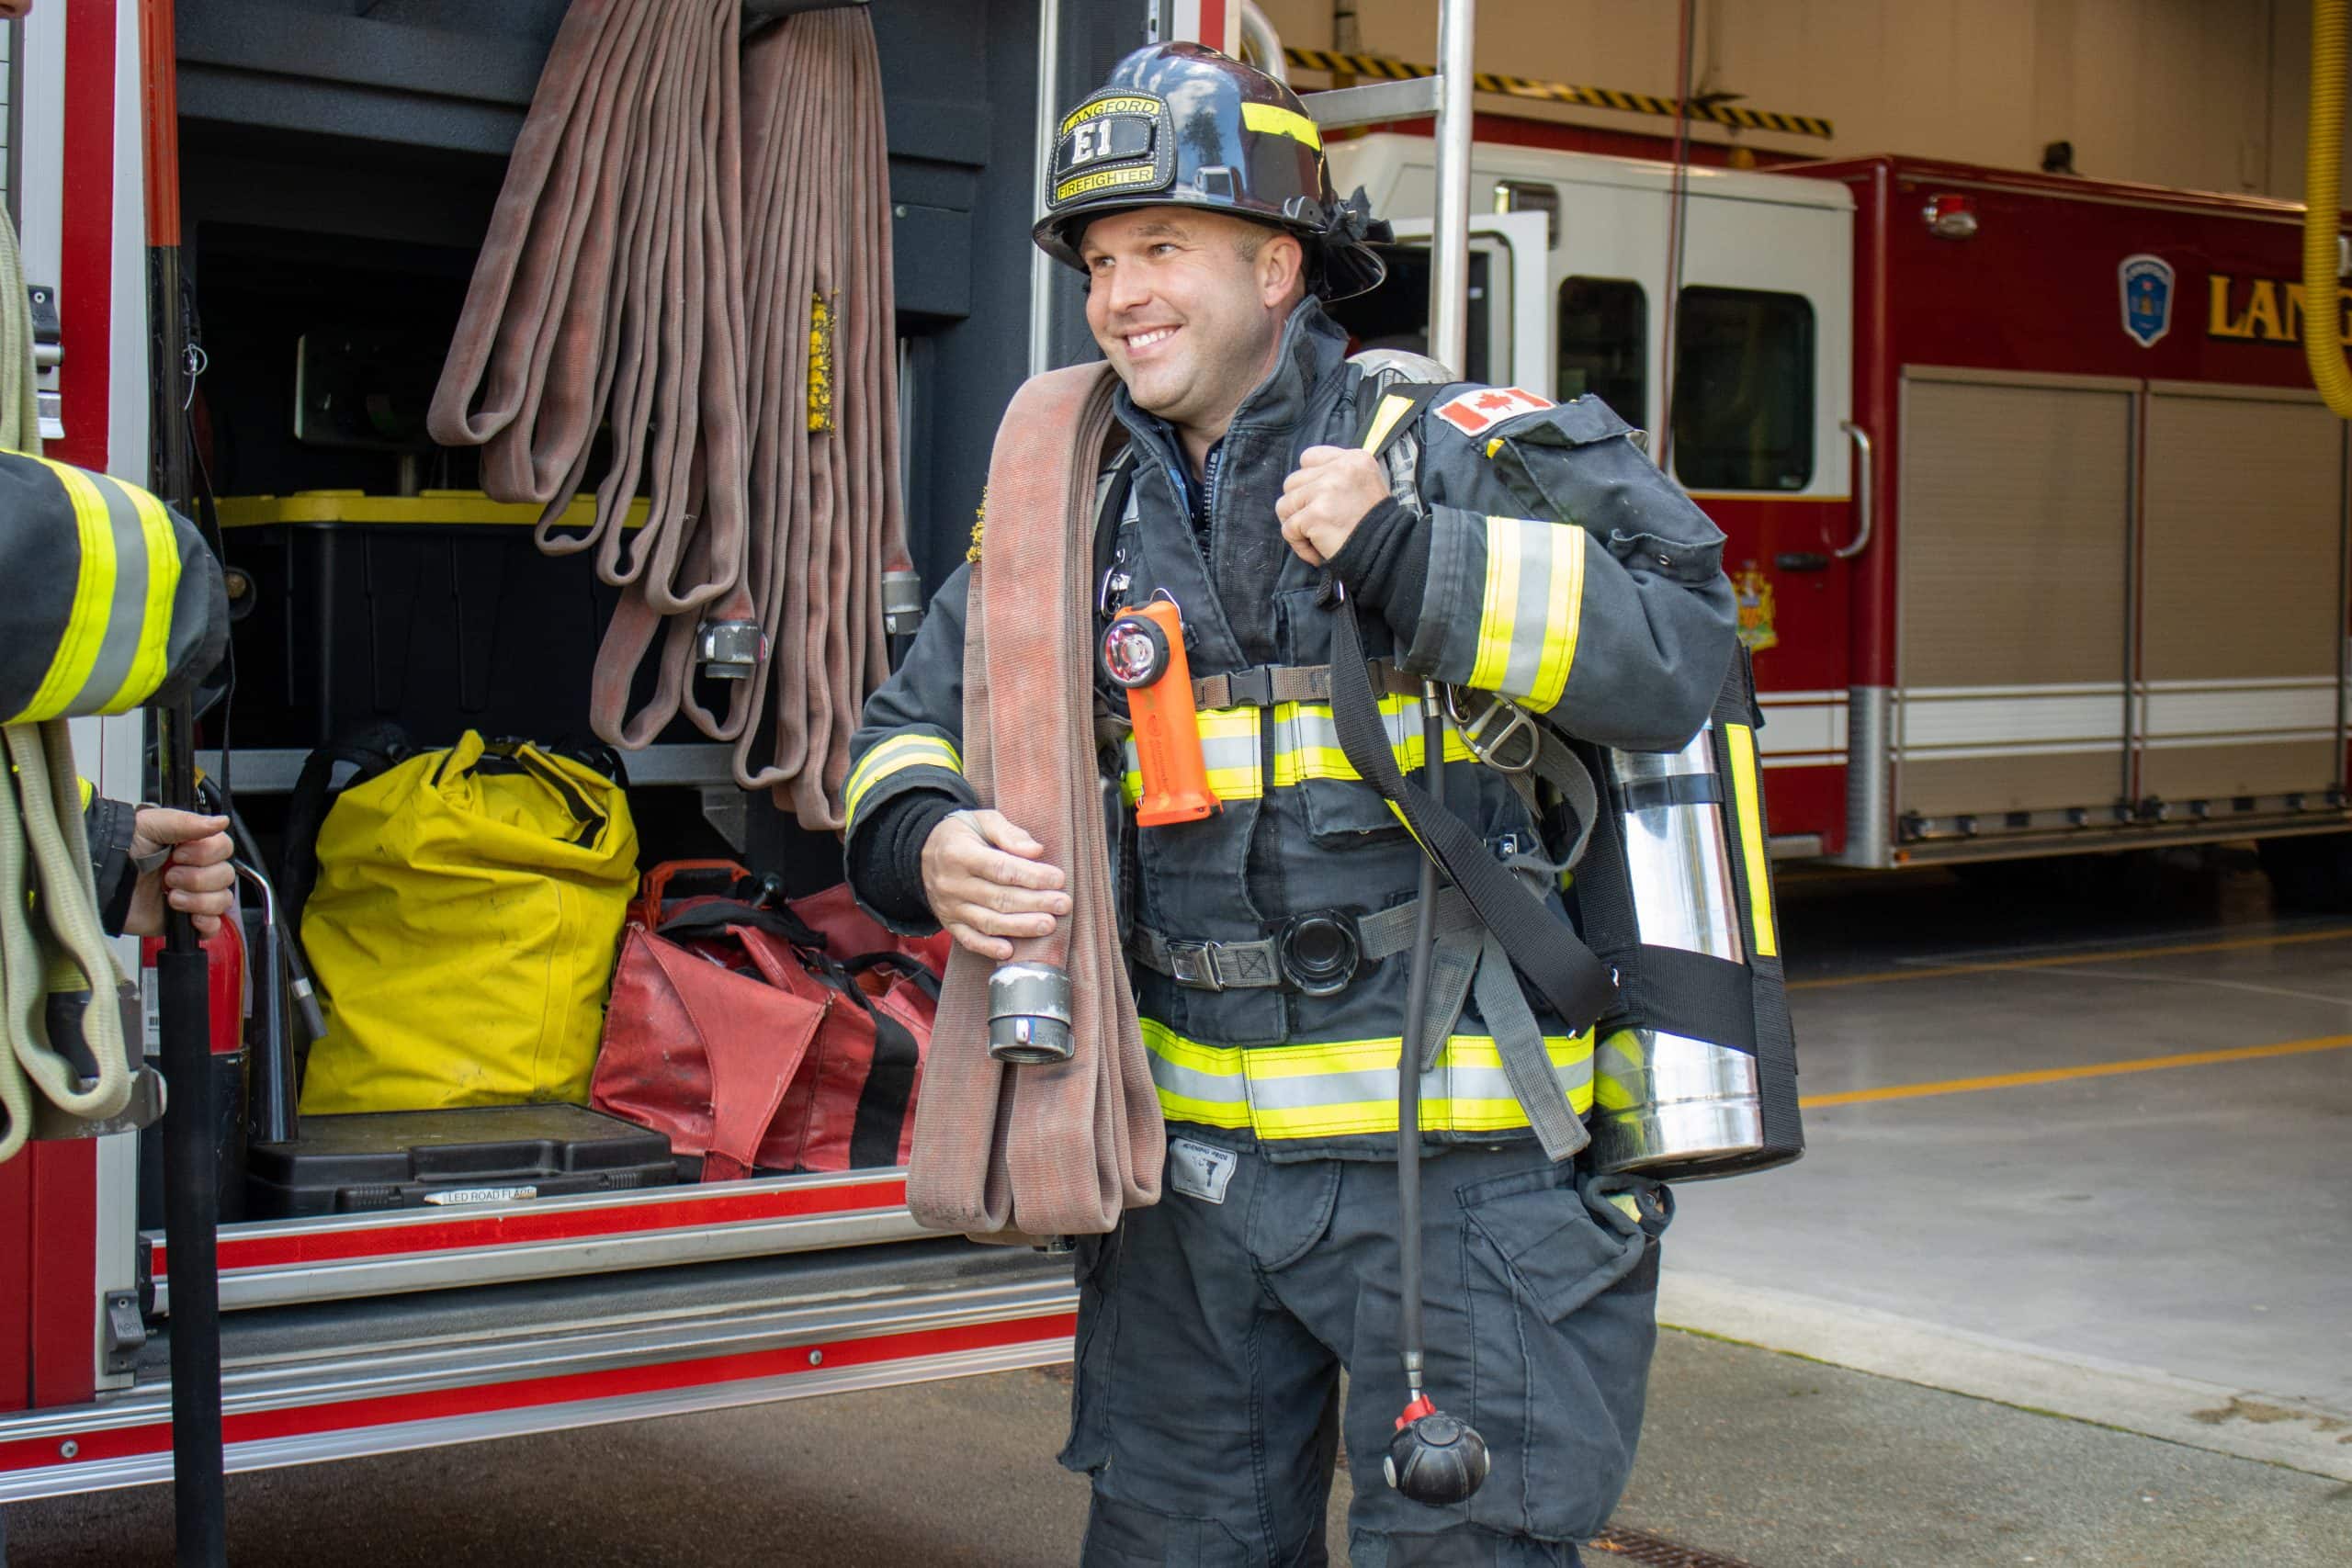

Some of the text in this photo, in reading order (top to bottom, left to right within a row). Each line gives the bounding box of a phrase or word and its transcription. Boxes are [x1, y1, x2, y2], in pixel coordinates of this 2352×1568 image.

[1065, 99, 1156, 133] LANGFORD
[1071, 118, 1112, 164] E1
[1057, 168, 1151, 199] FIREFIGHTER
[448, 1191, 469, 1202] LED
[470, 1190, 500, 1201] ROAD
